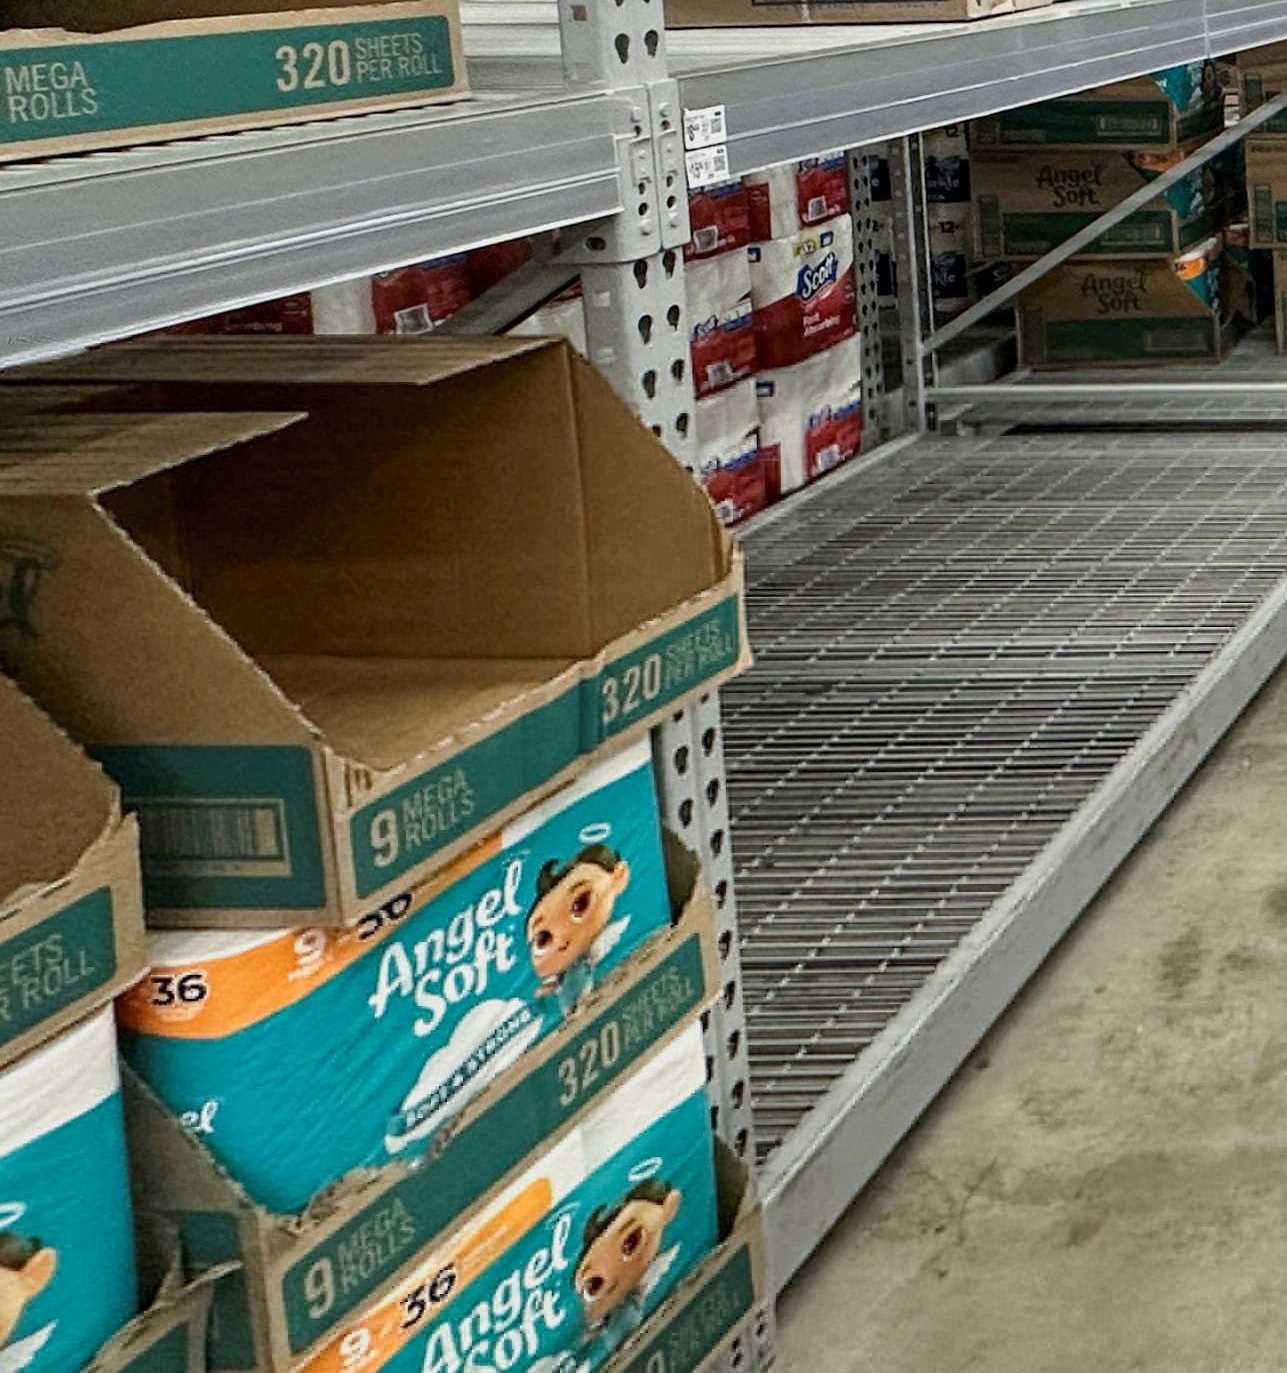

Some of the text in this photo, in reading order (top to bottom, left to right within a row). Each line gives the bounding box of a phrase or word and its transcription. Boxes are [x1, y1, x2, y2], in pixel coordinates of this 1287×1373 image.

[4, 62, 88, 96] MEGA
[275, 33, 424, 93] 320 SHEETS
[357, 52, 442, 84] PER ROLL
[8, 88, 98, 124] ROLLS
[1035, 162, 1108, 189] Angel
[1052, 185, 1100, 208] Soft
[1080, 267, 1148, 297] Angel
[1098, 292, 1144, 315] Soft
[602, 655, 662, 723] 320
[369, 768, 467, 868] 9 MEGA
[405, 789, 476, 851] ROLLS
[369, 859, 523, 1019] Angel
[21, 949, 97, 1009] ROLL
[151, 973, 208, 1007] 36
[414, 928, 517, 1037] Soft
[558, 1022, 619, 1106] 320
[305, 1200, 409, 1318] 9 MEGA
[342, 1221, 417, 1294] ROLLS
[401, 1261, 458, 1328] 36
[421, 1211, 573, 1373] Angel
[340, 1328, 371, 1359] 9
[463, 1282, 566, 1373] Soft
